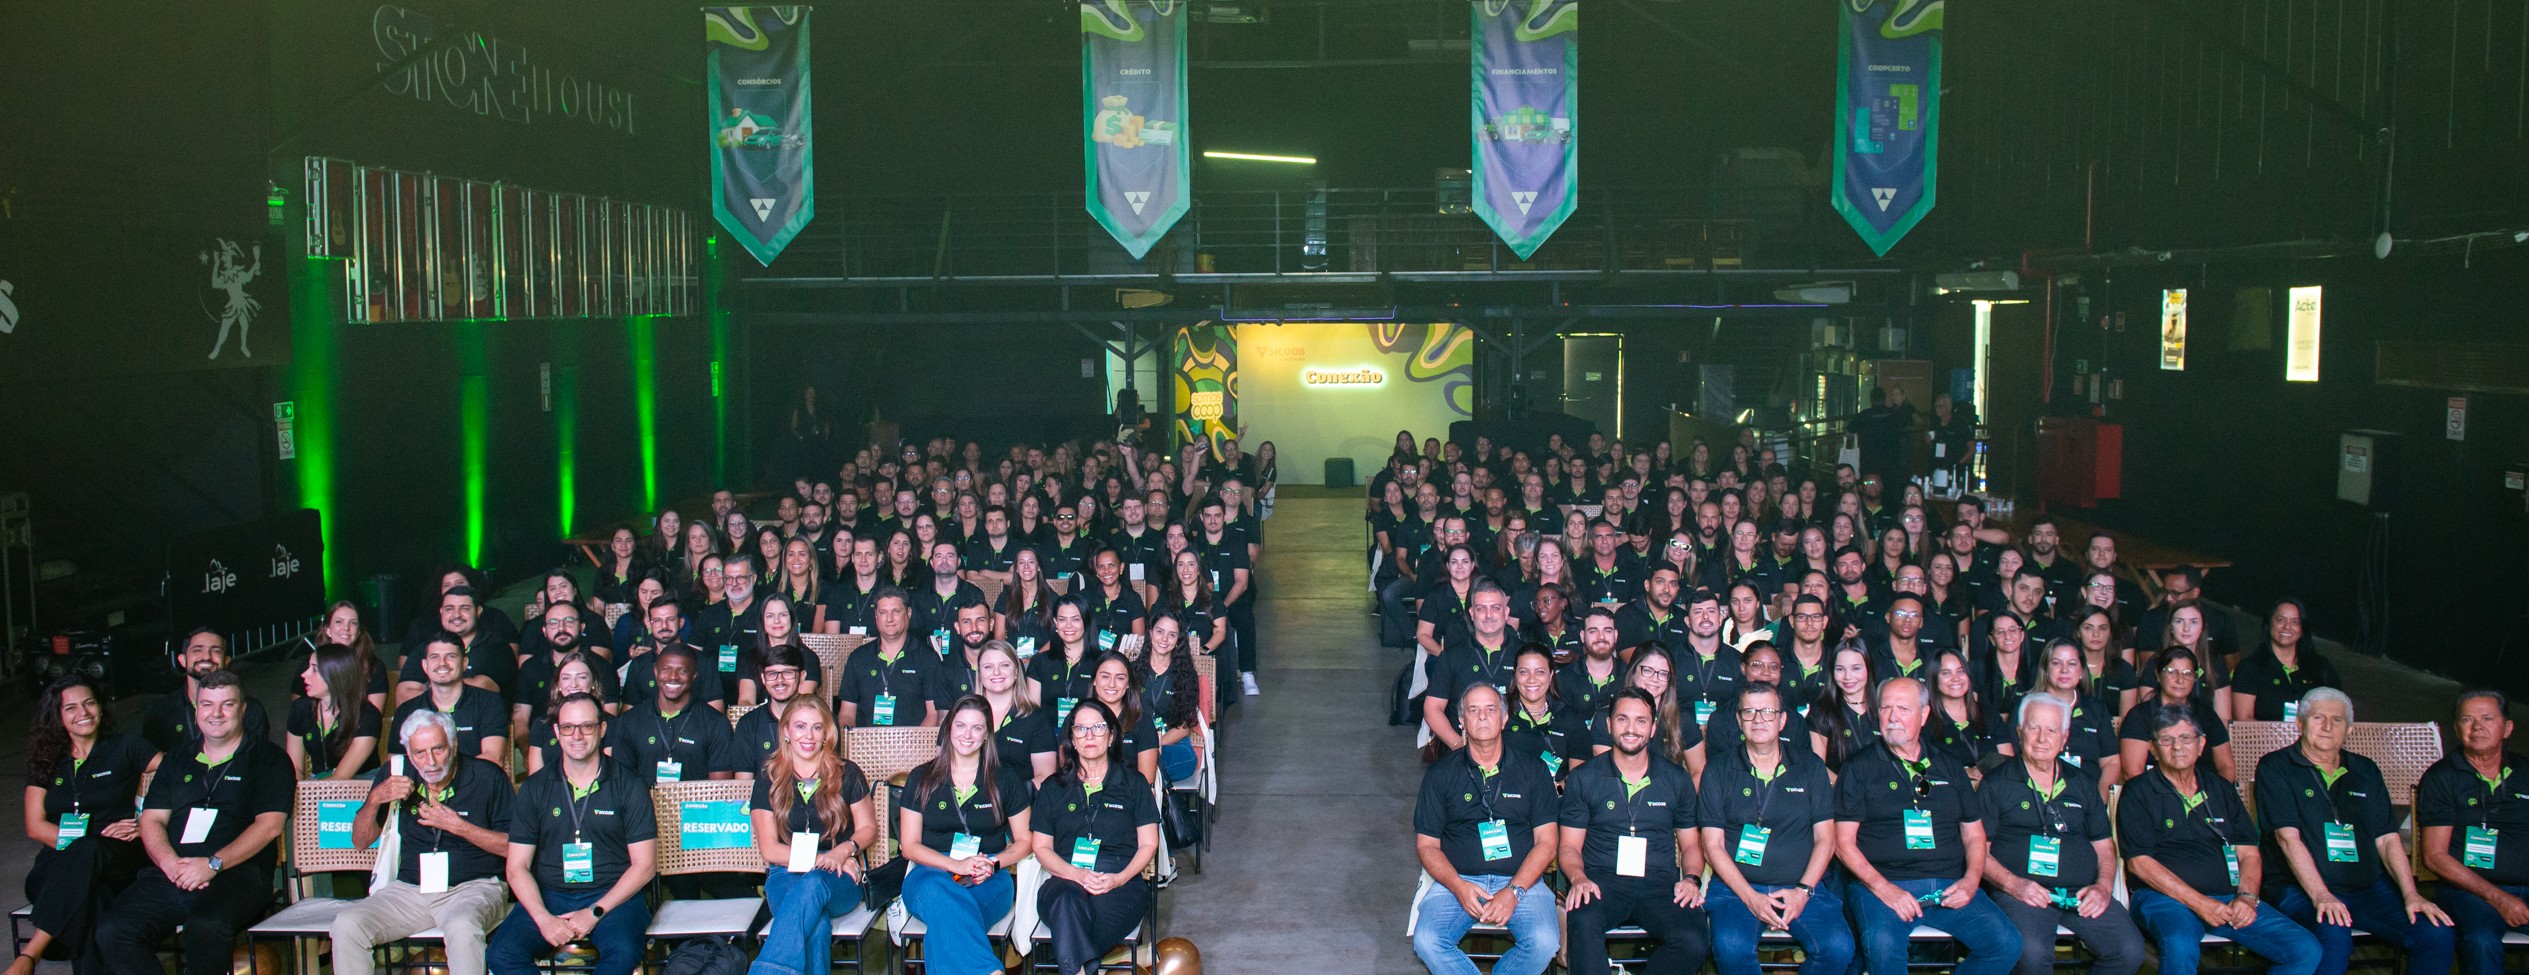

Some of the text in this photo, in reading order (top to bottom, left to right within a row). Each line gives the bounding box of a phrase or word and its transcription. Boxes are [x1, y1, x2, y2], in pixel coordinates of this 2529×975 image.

[1119, 67, 1151, 75] CRÉDITO
[737, 77, 782, 85] CONSÓRCIOS
[1304, 369, 1383, 384] Conexão
[1192, 392, 1222, 404] somos
[1192, 404, 1222, 424] coop
[269, 556, 300, 579] laje
[201, 570, 237, 594] laje
[320, 822, 353, 832] RESER
[683, 822, 749, 833] RESERVADO
